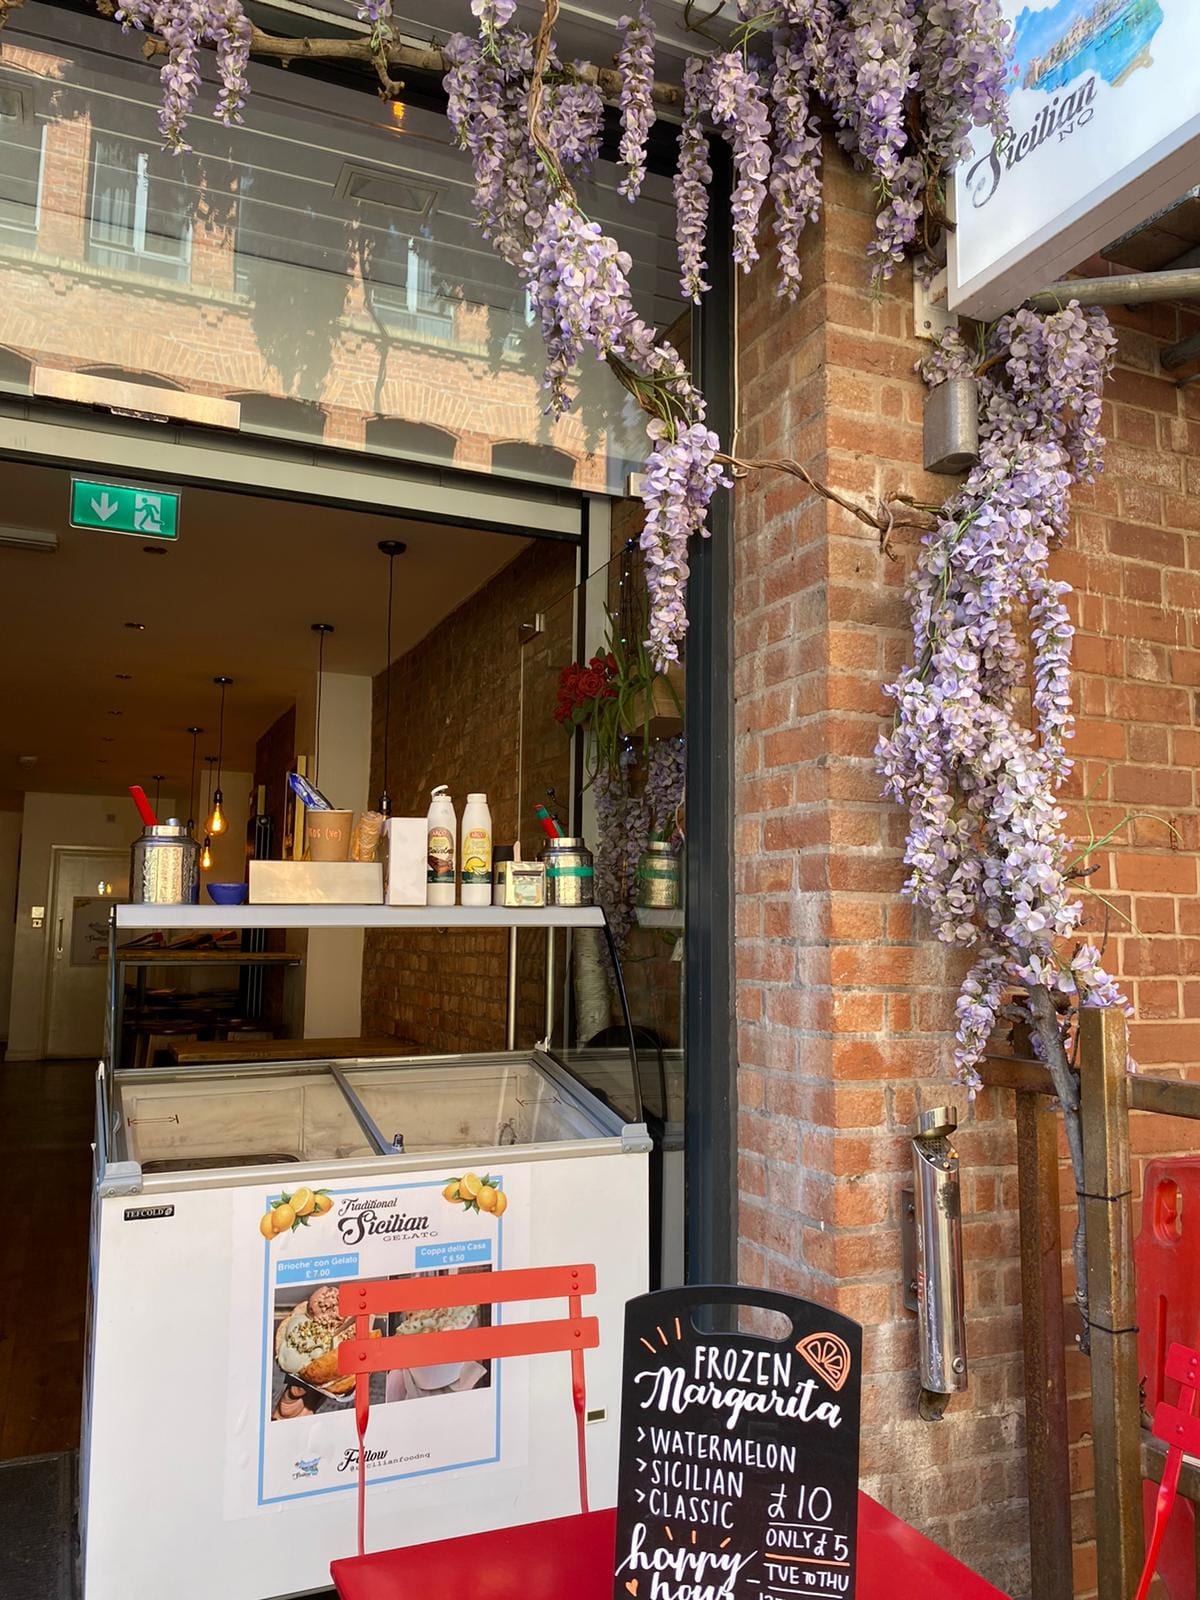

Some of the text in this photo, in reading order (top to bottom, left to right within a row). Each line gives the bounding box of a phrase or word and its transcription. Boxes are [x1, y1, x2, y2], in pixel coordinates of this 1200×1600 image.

[1057, 108, 1094, 143] NQ
[965, 76, 1097, 208] Sicilian
[125, 1207, 164, 1218] TEFCOLD
[338, 1197, 398, 1216] Traditional
[337, 1209, 430, 1246] Sicilian
[382, 1231, 439, 1242] GELATO
[331, 1256, 358, 1265] Gelato
[420, 1242, 486, 1256] Coppa della Casa
[695, 1346, 792, 1387] FROZEN
[634, 1366, 843, 1430] Margarita
[350, 1453, 431, 1472] @cilianfoodnq
[650, 1426, 796, 1473] WATERMELON
[651, 1460, 744, 1498] SICILIAN
[649, 1488, 735, 1529] CLASSIC
[765, 1528, 815, 1549] ONLY
[614, 1522, 758, 1593] happy
[650, 1571, 735, 1600] hour
[763, 1563, 800, 1584] TUE
[816, 1571, 850, 1592] THU
